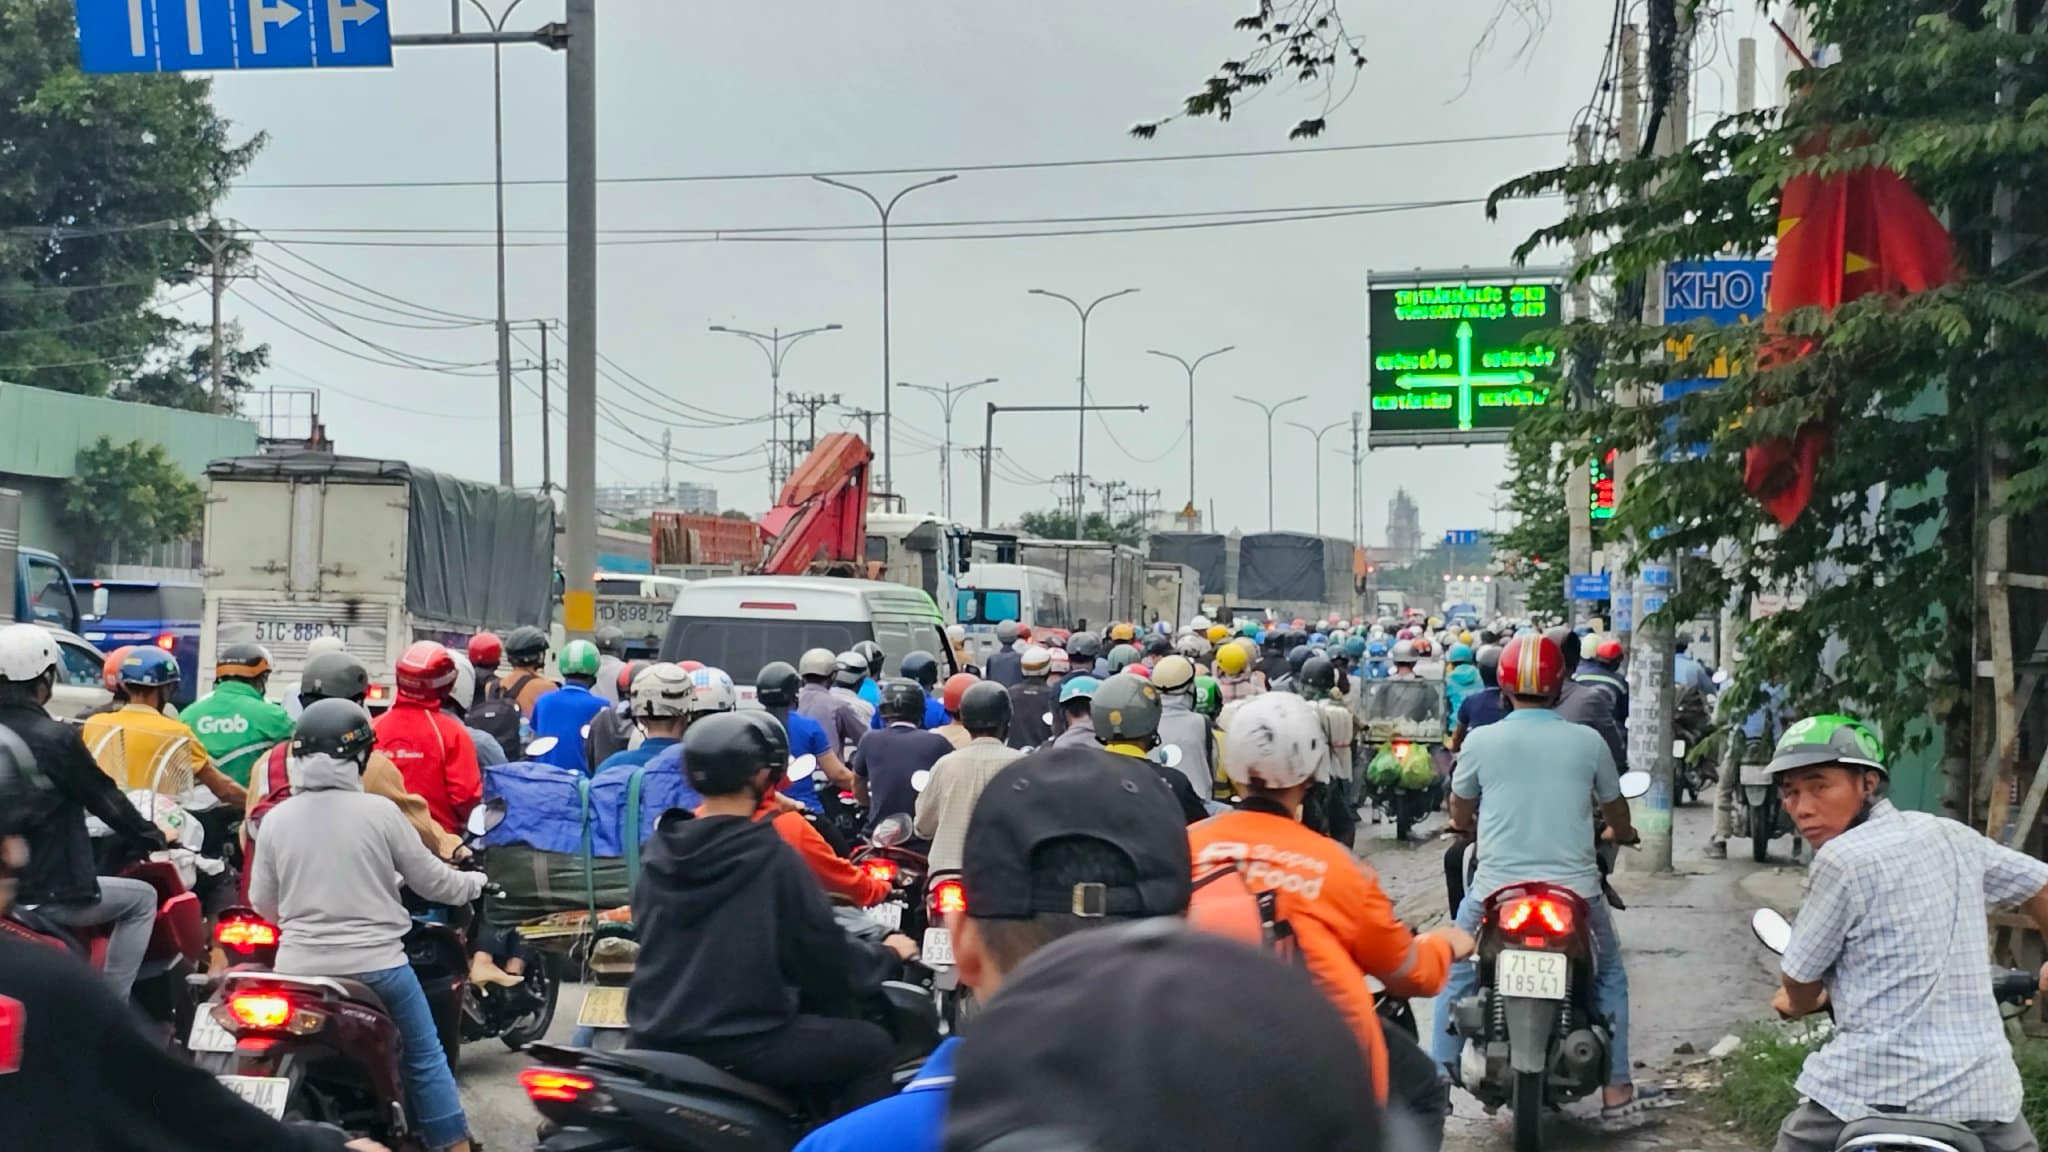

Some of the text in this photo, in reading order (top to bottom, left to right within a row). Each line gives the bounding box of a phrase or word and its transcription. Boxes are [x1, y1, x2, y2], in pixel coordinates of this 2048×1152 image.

[1665, 270, 1754, 309] KHO
[197, 713, 249, 734] Grab
[1246, 861, 1325, 900] Food
[1511, 954, 1556, 975] 71-C2
